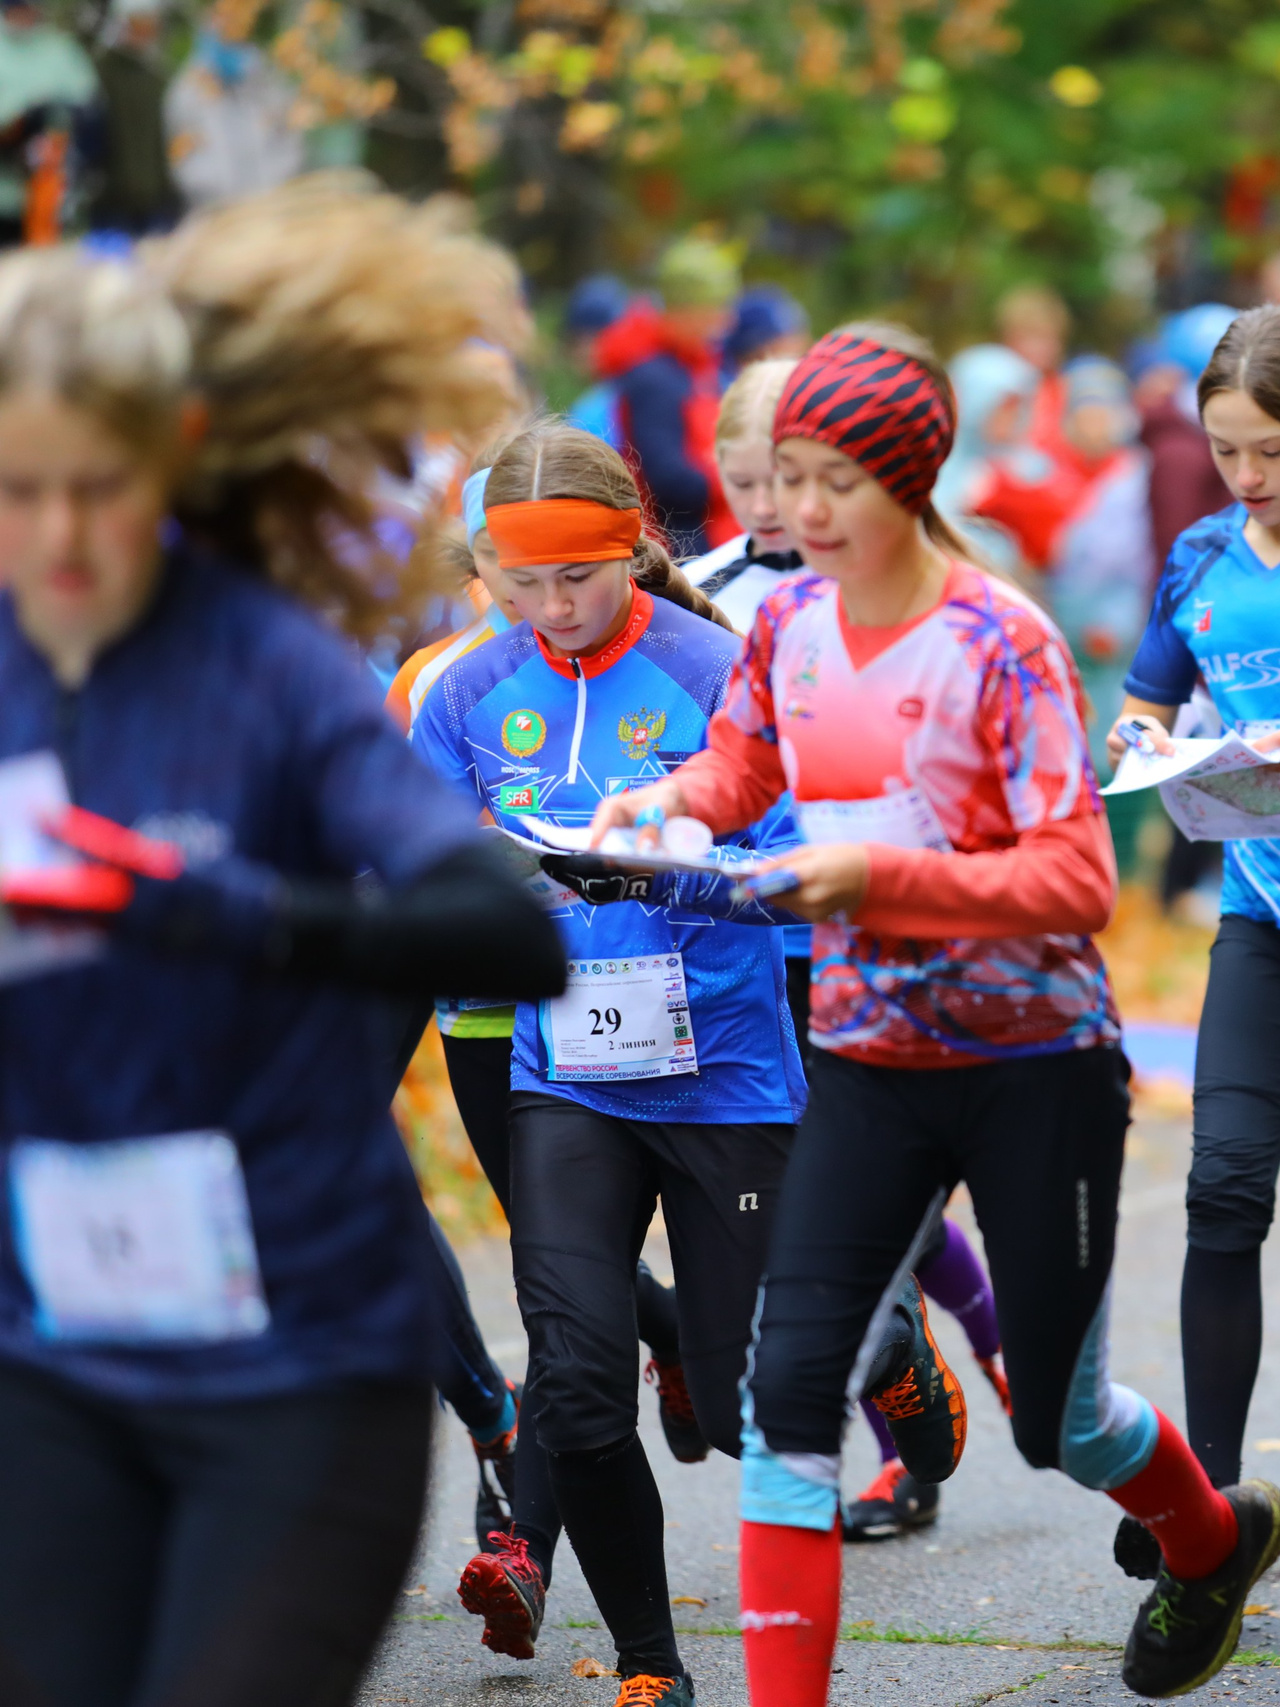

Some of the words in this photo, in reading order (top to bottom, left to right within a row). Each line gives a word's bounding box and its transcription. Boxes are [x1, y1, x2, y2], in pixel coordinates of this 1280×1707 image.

[505, 791, 529, 805] SFR
[587, 1007, 622, 1036] 29
[608, 1040, 615, 1051] 2
[618, 1039, 656, 1049] линия
[605, 1068, 661, 1080] СОРЕВНОВАНИЯ
